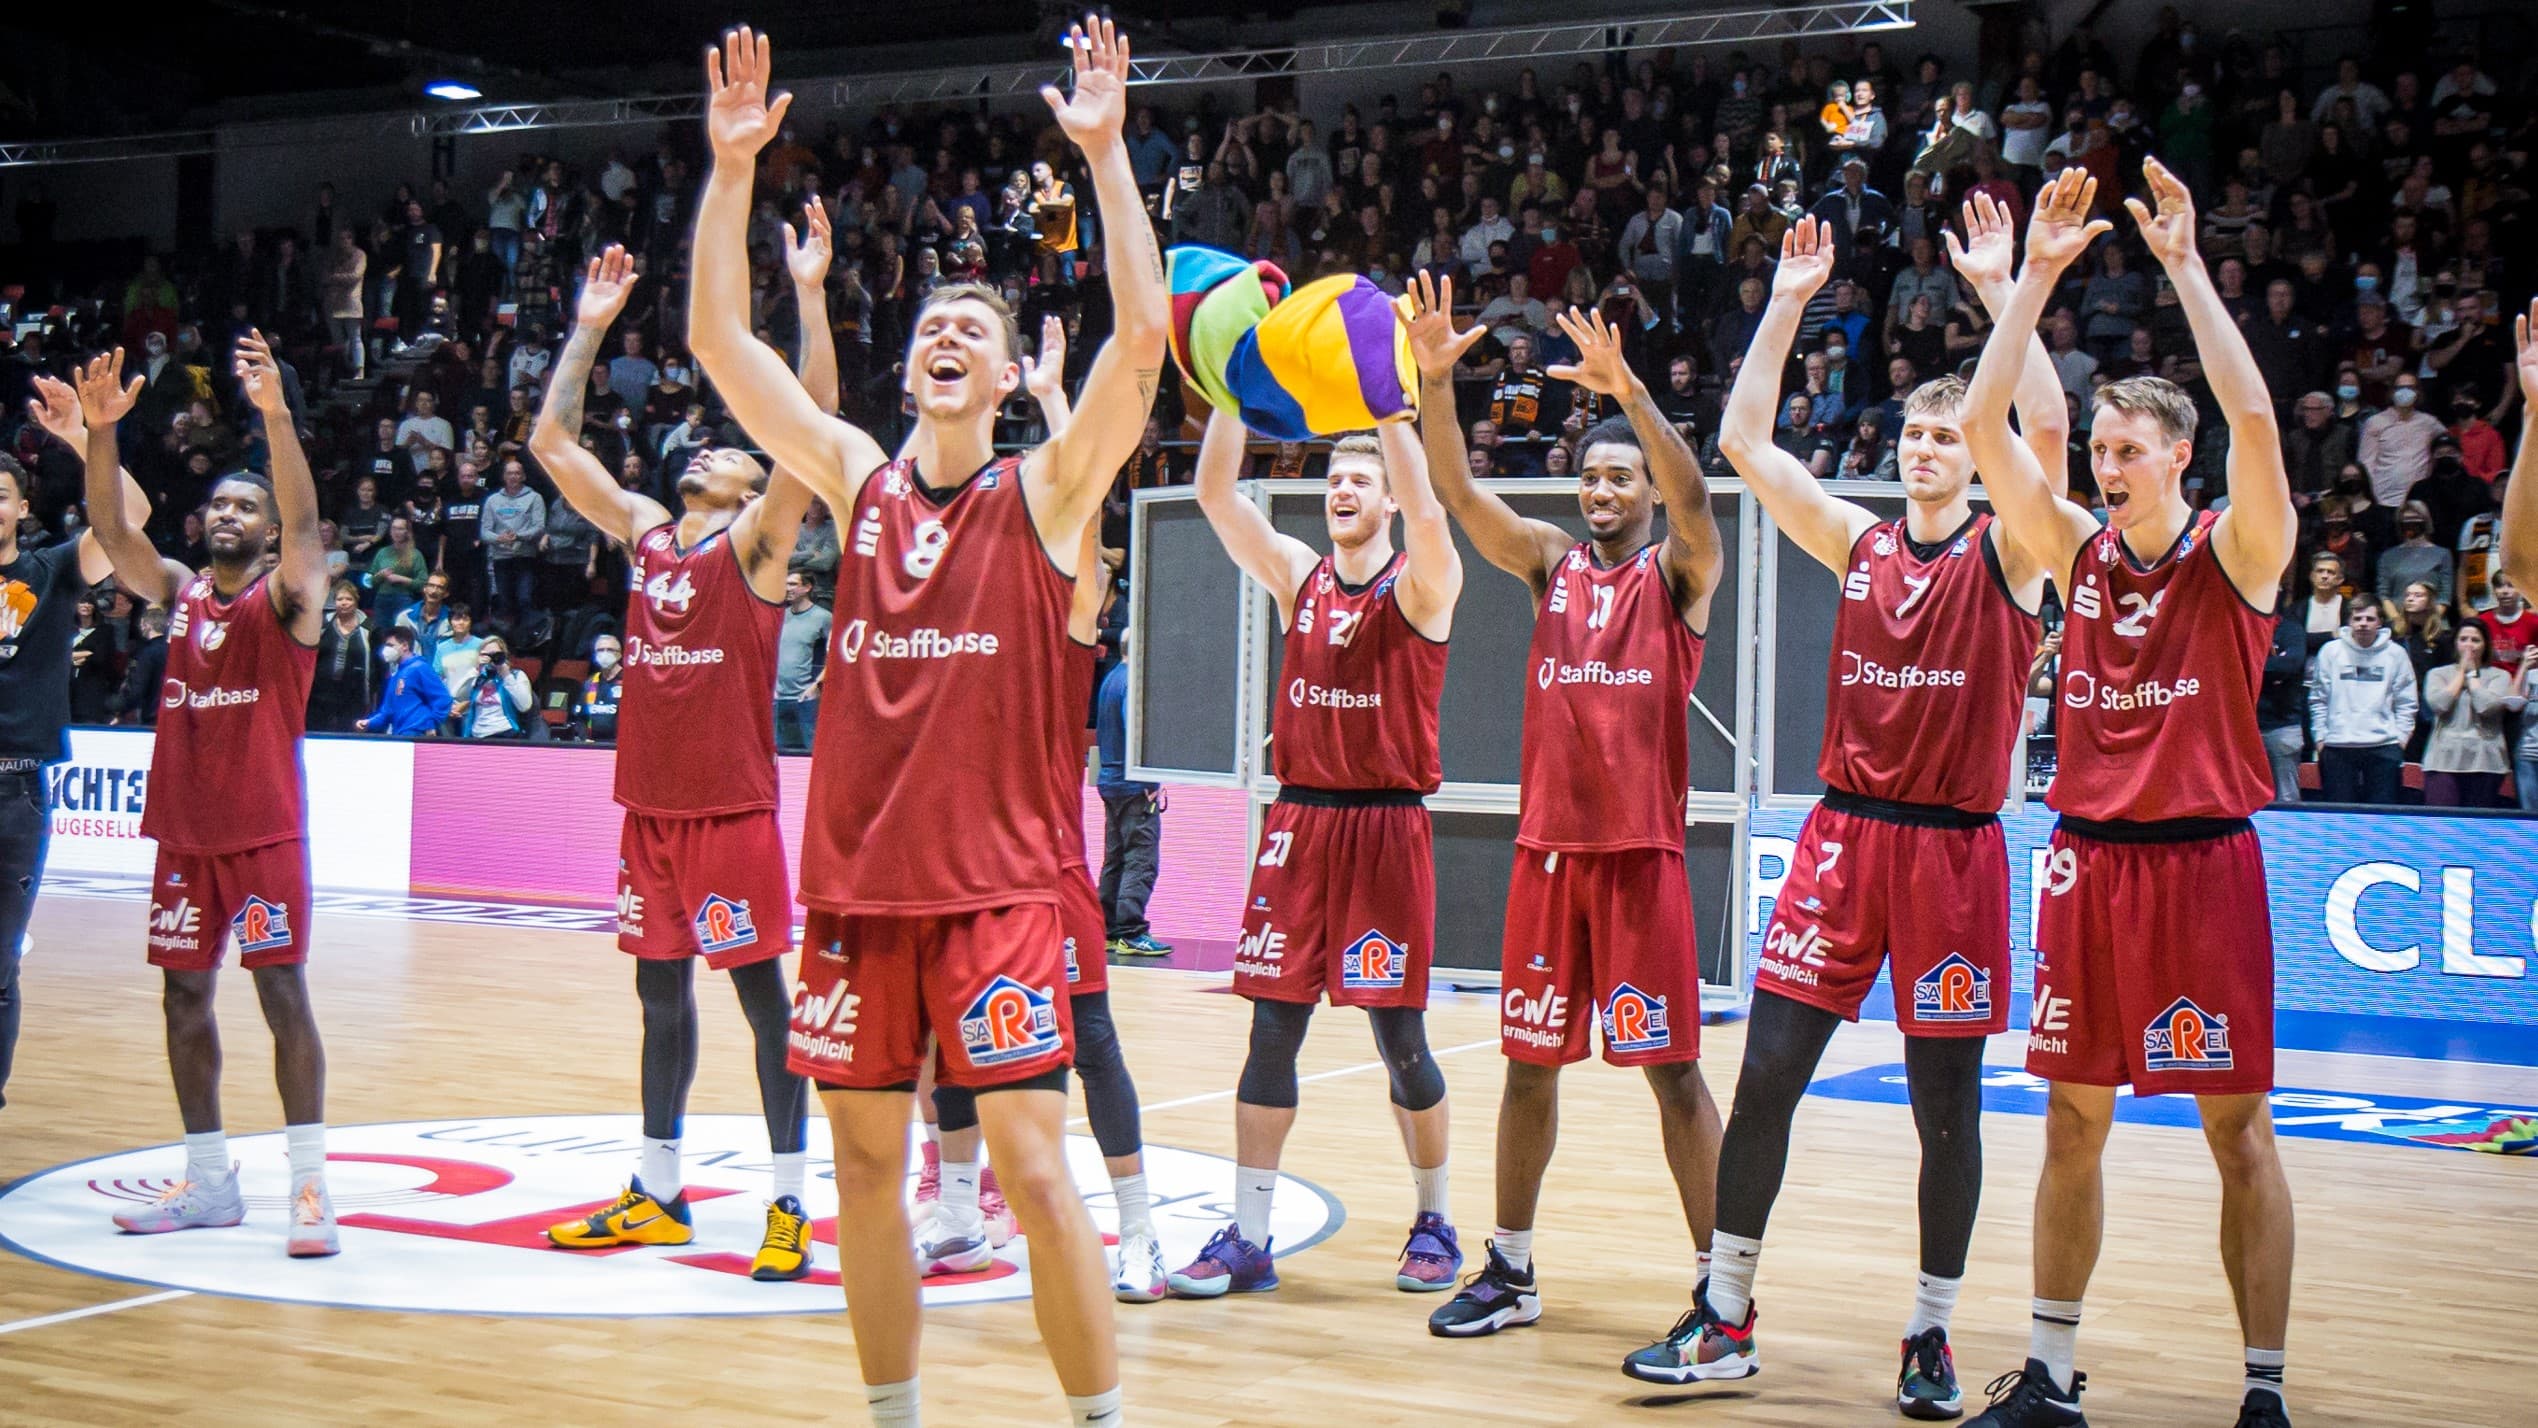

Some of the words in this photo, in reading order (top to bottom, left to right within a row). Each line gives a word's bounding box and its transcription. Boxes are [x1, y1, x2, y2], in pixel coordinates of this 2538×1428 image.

[904, 520, 949, 579] 8
[647, 570, 696, 611] 44
[1895, 576, 1931, 619] 7
[1328, 609, 1363, 648] 21
[642, 644, 725, 666] Saffbase
[2099, 678, 2200, 711] Staffbse
[49, 766, 151, 813] ICHTE
[49, 817, 148, 839] UGESELL
[1259, 831, 1294, 867] 21
[1815, 842, 1843, 883] 7
[2324, 859, 2538, 979] CL
[1766, 921, 1833, 967] CWE
[1504, 984, 1568, 1028] CWE
[1915, 964, 1989, 1010] SAREI
[961, 988, 1056, 1051] SAREI
[2144, 1008, 2228, 1059] SAREI
